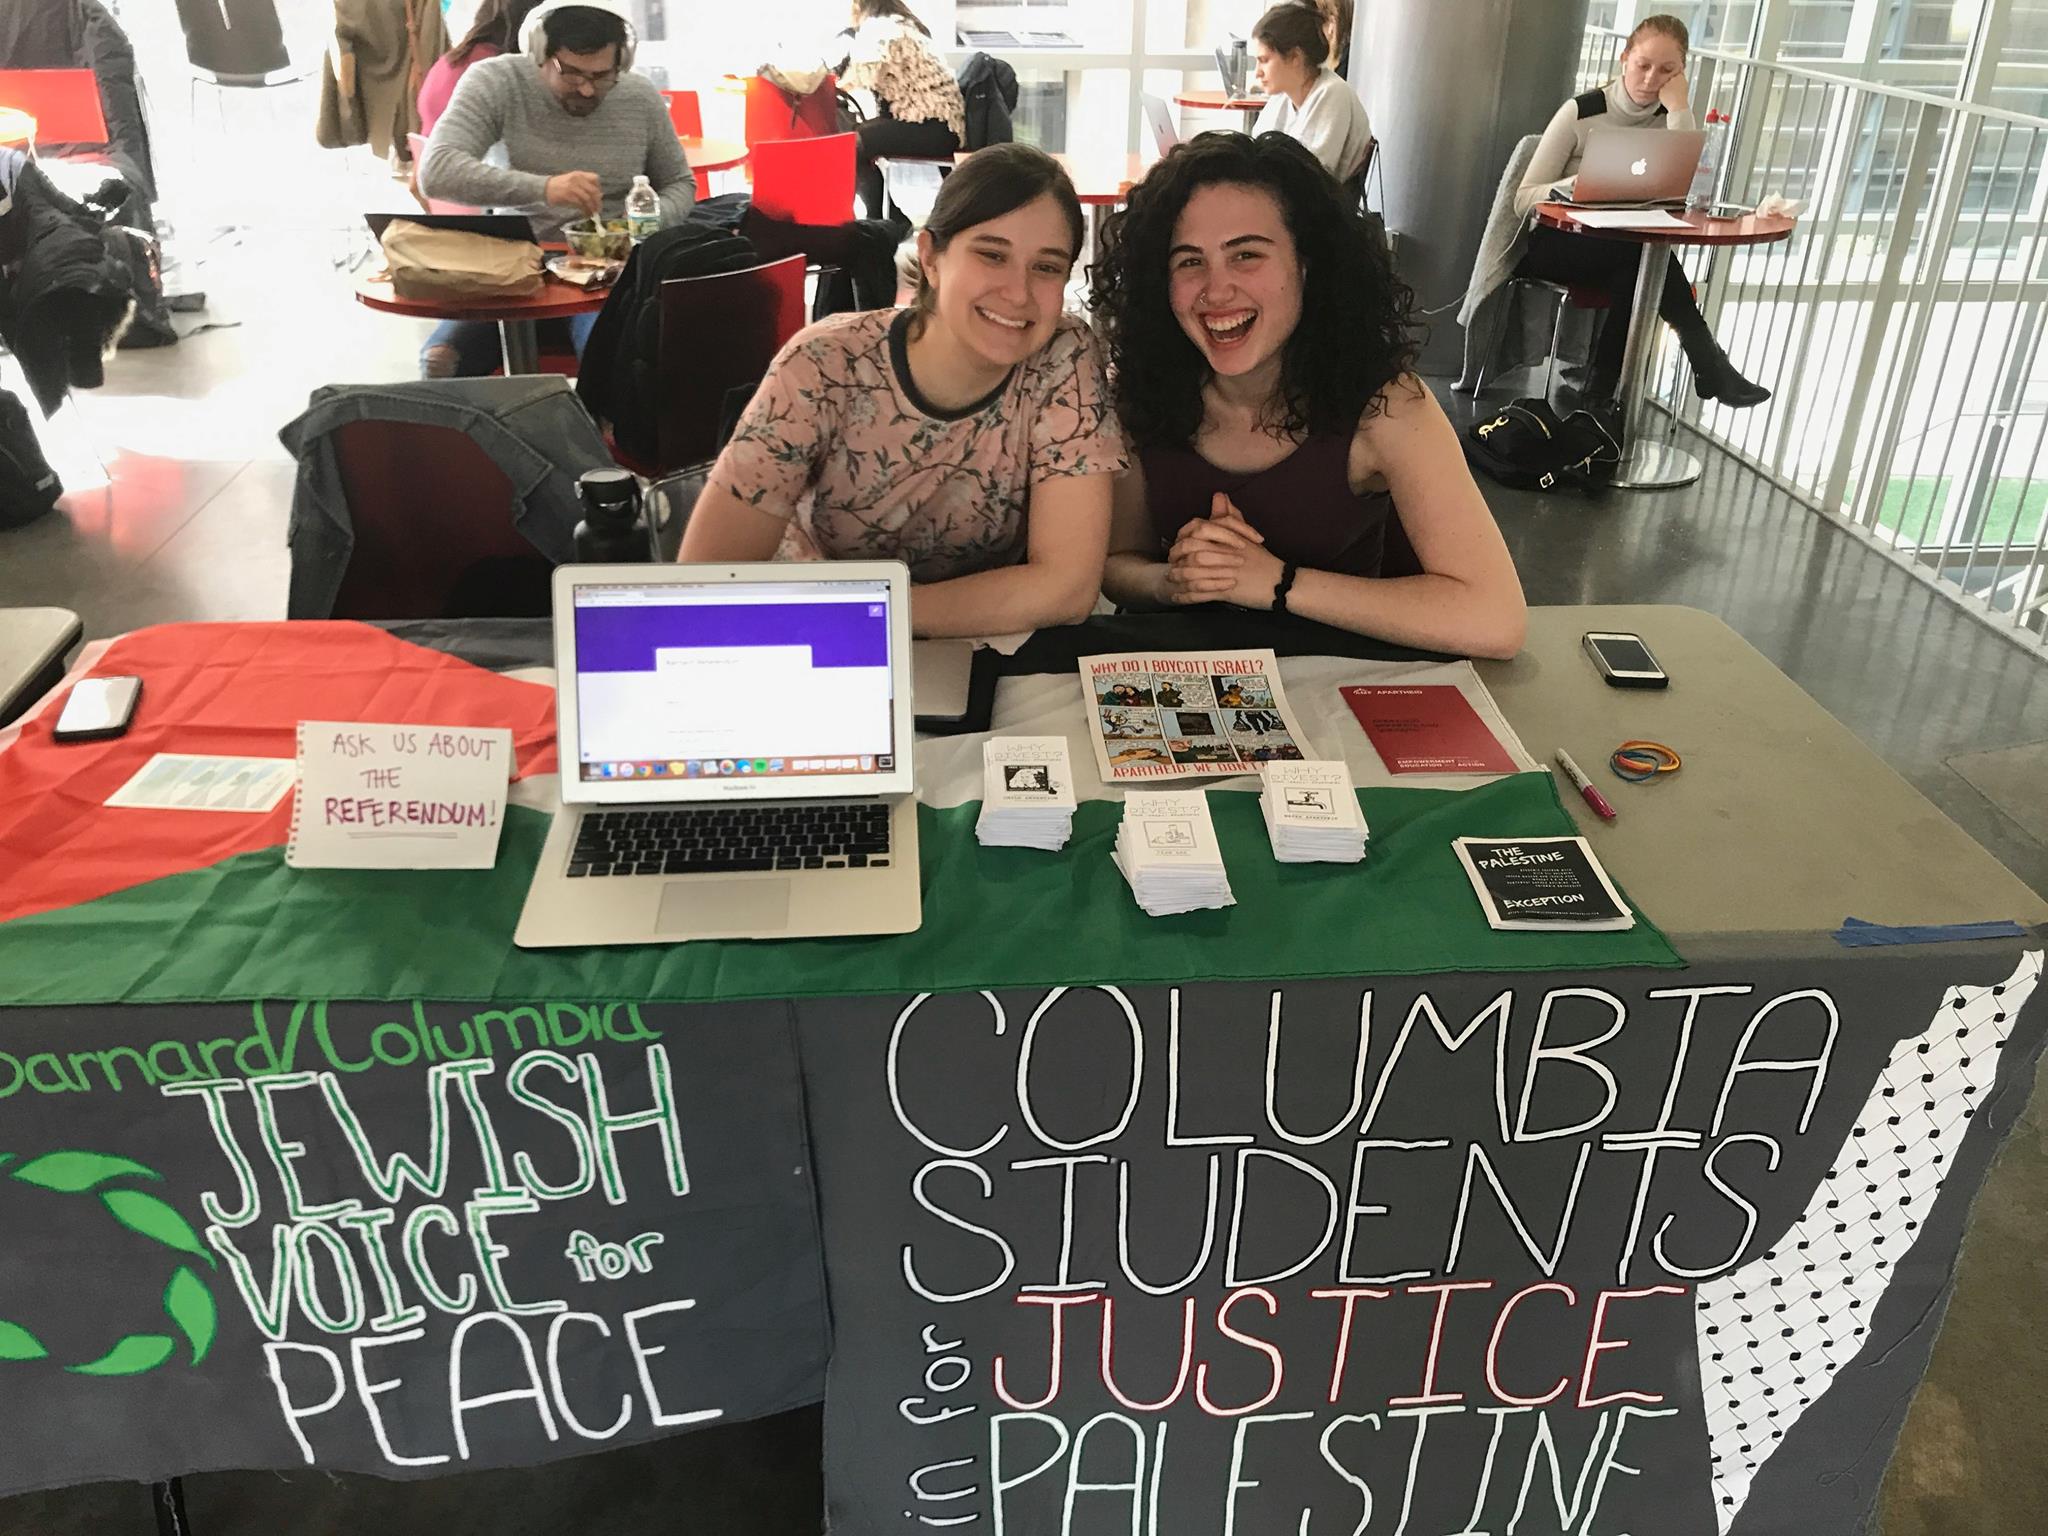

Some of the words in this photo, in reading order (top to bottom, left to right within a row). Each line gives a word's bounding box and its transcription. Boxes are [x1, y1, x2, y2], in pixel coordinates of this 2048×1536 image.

[1090, 662, 1117, 675] WHY
[1122, 660, 1140, 673] DO
[1143, 660, 1149, 673] I
[1152, 660, 1209, 674] BOYCOTT
[1212, 660, 1264, 674] ISRAEL?
[333, 733, 376, 758] ASK
[393, 733, 417, 754] US
[428, 732, 497, 761] ABOUT
[1006, 743, 1046, 752] WHY
[360, 767, 402, 789] THE
[1113, 763, 1191, 778] APARTHEID:
[1194, 763, 1211, 775] WE
[1217, 761, 1259, 772] DON'T
[1283, 766, 1324, 774] WHY
[325, 797, 496, 827] REFERENDUM!
[1141, 798, 1182, 806] WHY
[1478, 851, 1564, 869] PALESTINE
[1490, 846, 1524, 857] THE
[1503, 893, 1585, 908] EXCEPTION
[887, 984, 1839, 1158] COLUMBIA
[161, 1044, 690, 1228] JEWISH
[903, 1134, 1780, 1304] STUDENTS
[205, 1200, 568, 1340] VOICE
[564, 1230, 664, 1283] for
[992, 1280, 1687, 1418] JUSTICE
[261, 1299, 724, 1467] PEACE
[899, 1323, 977, 1425] for
[990, 1404, 1680, 1536] PALESTINE
[903, 1456, 979, 1527] in
